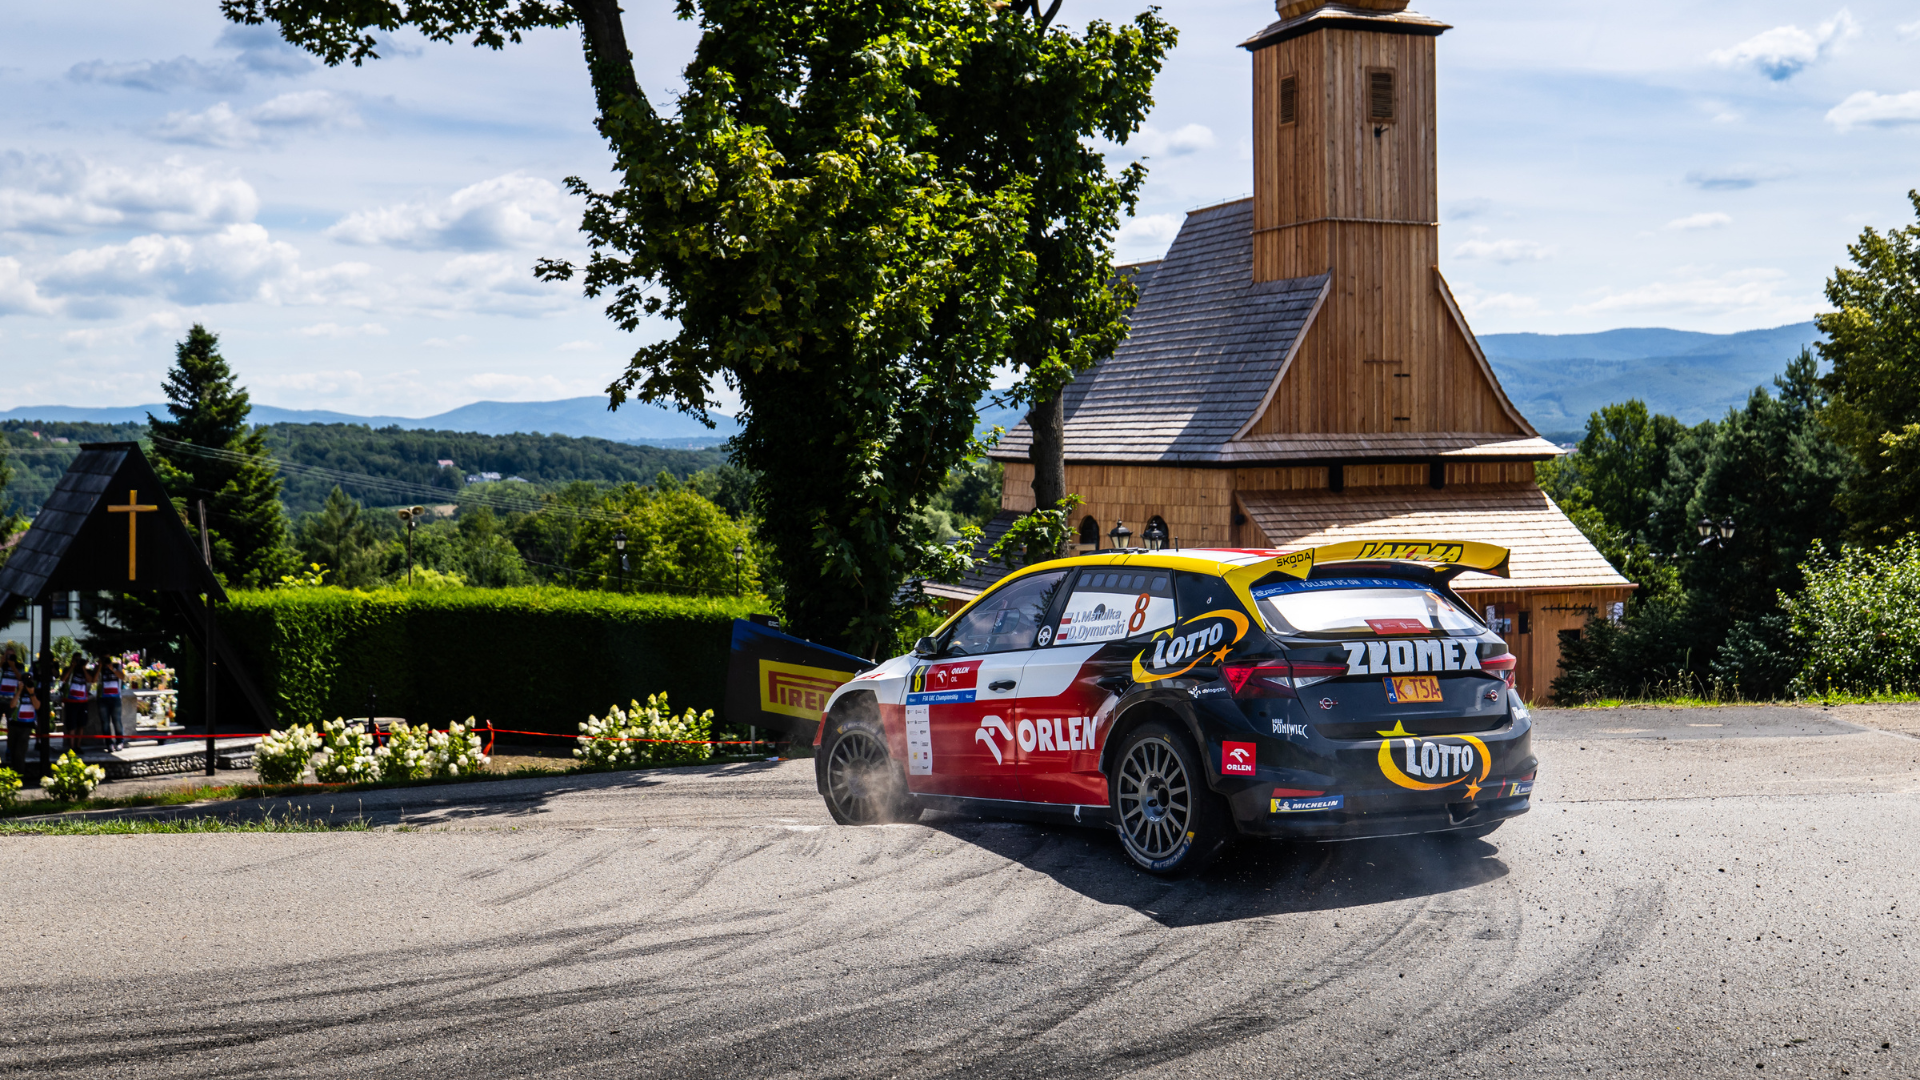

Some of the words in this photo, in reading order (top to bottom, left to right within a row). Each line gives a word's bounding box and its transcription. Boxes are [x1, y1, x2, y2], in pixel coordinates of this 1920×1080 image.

[1353, 542, 1464, 563] LAKMA
[1299, 579, 1334, 588] FOLLOW
[1335, 578, 1348, 586] US
[1128, 593, 1150, 632] 8
[1067, 620, 1126, 641] D.Dymurski
[1153, 623, 1223, 669] LOTTO
[914, 665, 925, 692] 8
[1394, 679, 1408, 699] K
[1412, 678, 1440, 699] T5A
[1017, 716, 1098, 752] ORLEN
[1272, 723, 1309, 739] PONIWIEC
[1403, 738, 1474, 778] LOTTO
[1292, 800, 1339, 809] MICHELIN
